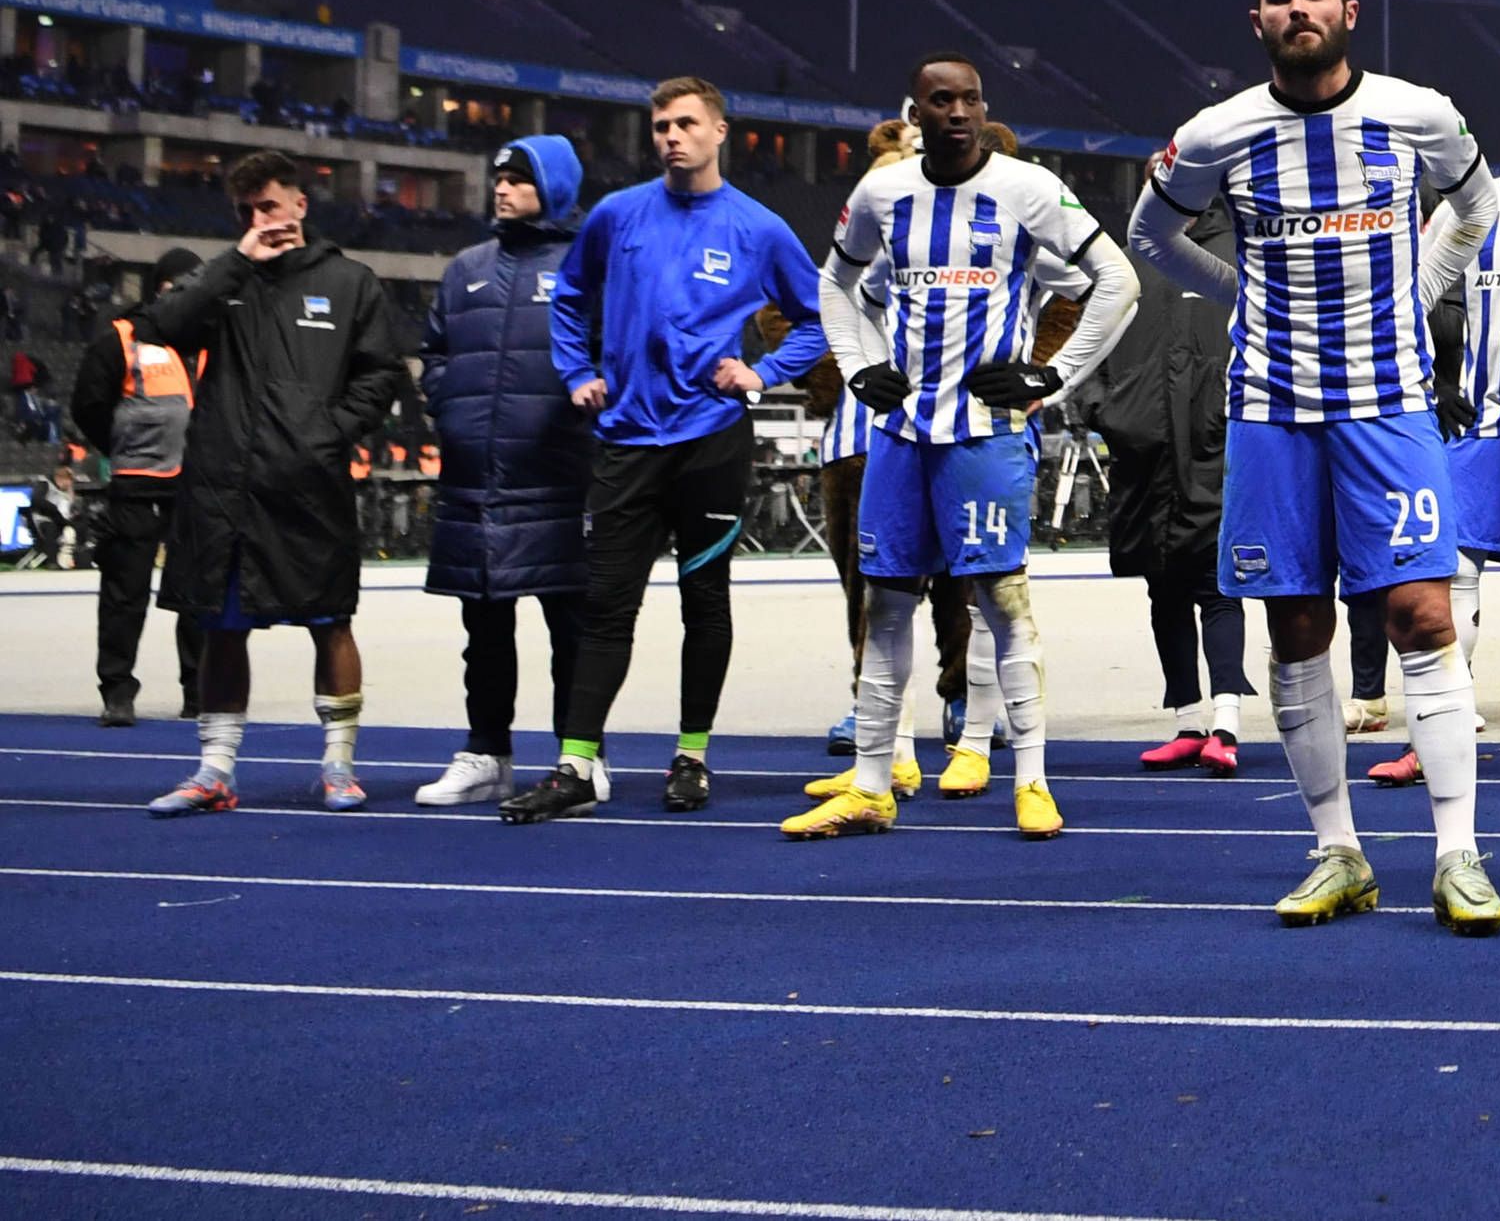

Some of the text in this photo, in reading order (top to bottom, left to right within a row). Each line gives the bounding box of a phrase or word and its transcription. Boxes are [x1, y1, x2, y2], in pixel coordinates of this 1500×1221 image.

[1254, 210, 1395, 238] AUTOHERO
[962, 500, 1008, 545] 14
[1385, 488, 1440, 546] 29
